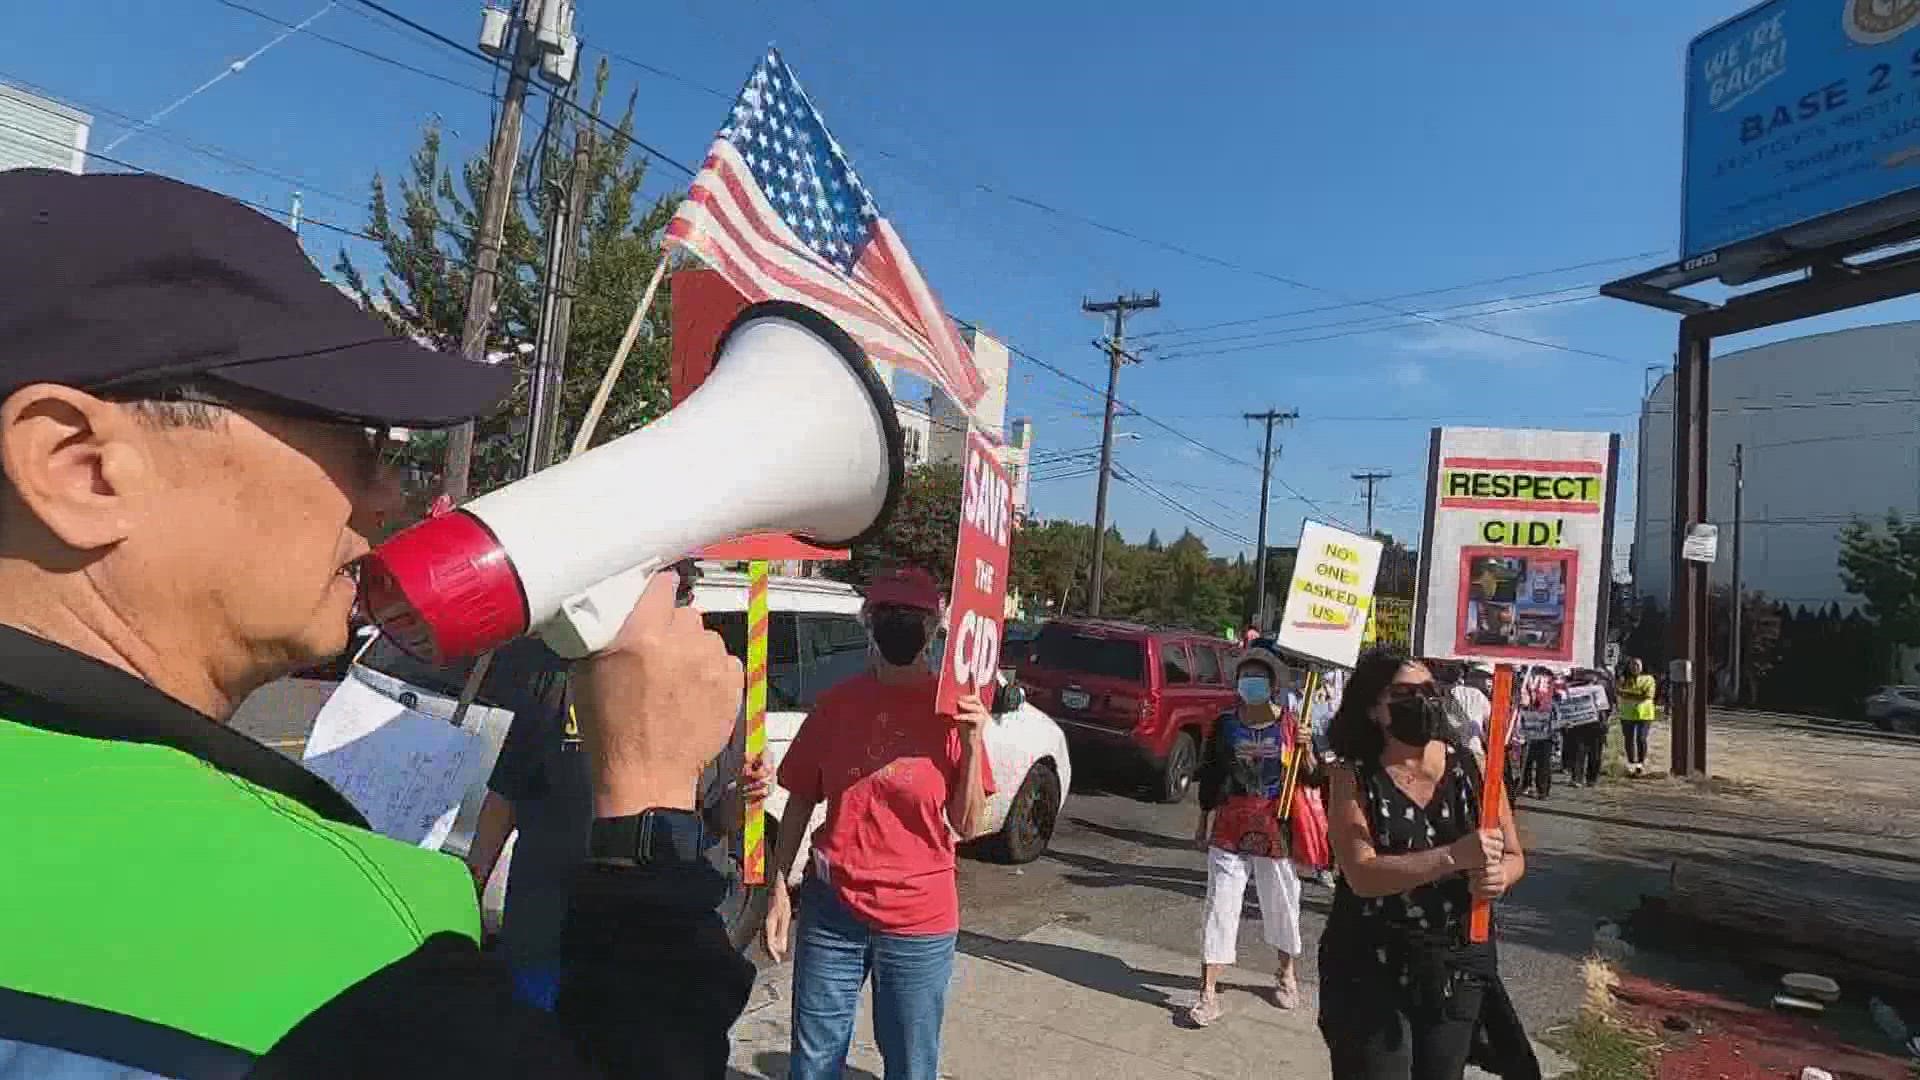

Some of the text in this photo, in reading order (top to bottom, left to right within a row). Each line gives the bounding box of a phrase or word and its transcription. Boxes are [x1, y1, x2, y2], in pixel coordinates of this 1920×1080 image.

[1739, 78, 1849, 145] BASE
[1866, 62, 1891, 95] 2
[1449, 473, 1594, 501] RESPECT
[1483, 518, 1563, 546] CID!
[1326, 543, 1351, 561] NO
[975, 556, 995, 595] THE
[1315, 563, 1352, 584] ONE
[1303, 581, 1358, 605] ASKED
[1312, 603, 1338, 621] US
[954, 609, 998, 686] CID
